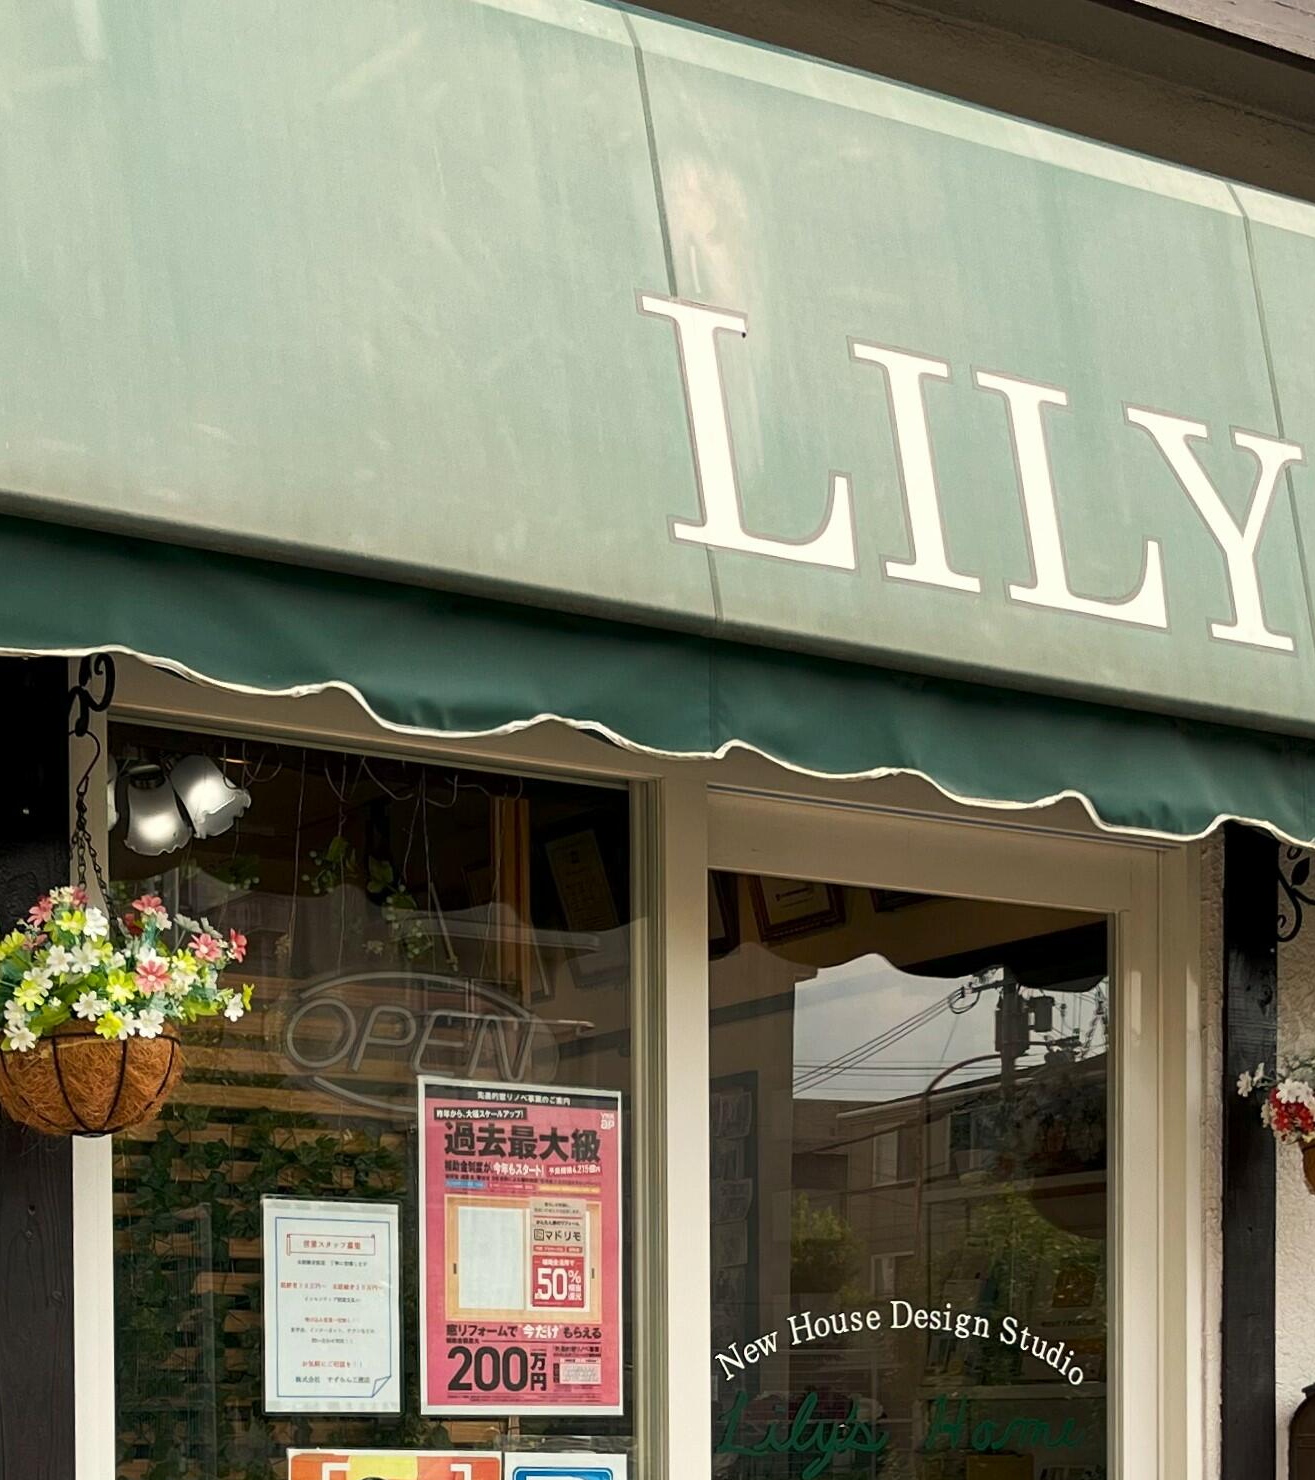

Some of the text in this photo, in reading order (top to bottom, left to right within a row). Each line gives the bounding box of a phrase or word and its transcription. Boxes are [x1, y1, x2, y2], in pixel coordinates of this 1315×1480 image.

[287, 997, 541, 1083] OPEN
[445, 1121, 601, 1163] 過去最大級
[563, 1326, 602, 1339] もらえる
[714, 1300, 1085, 1387] New House Design Studio
[924, 1391, 1086, 1451] Home
